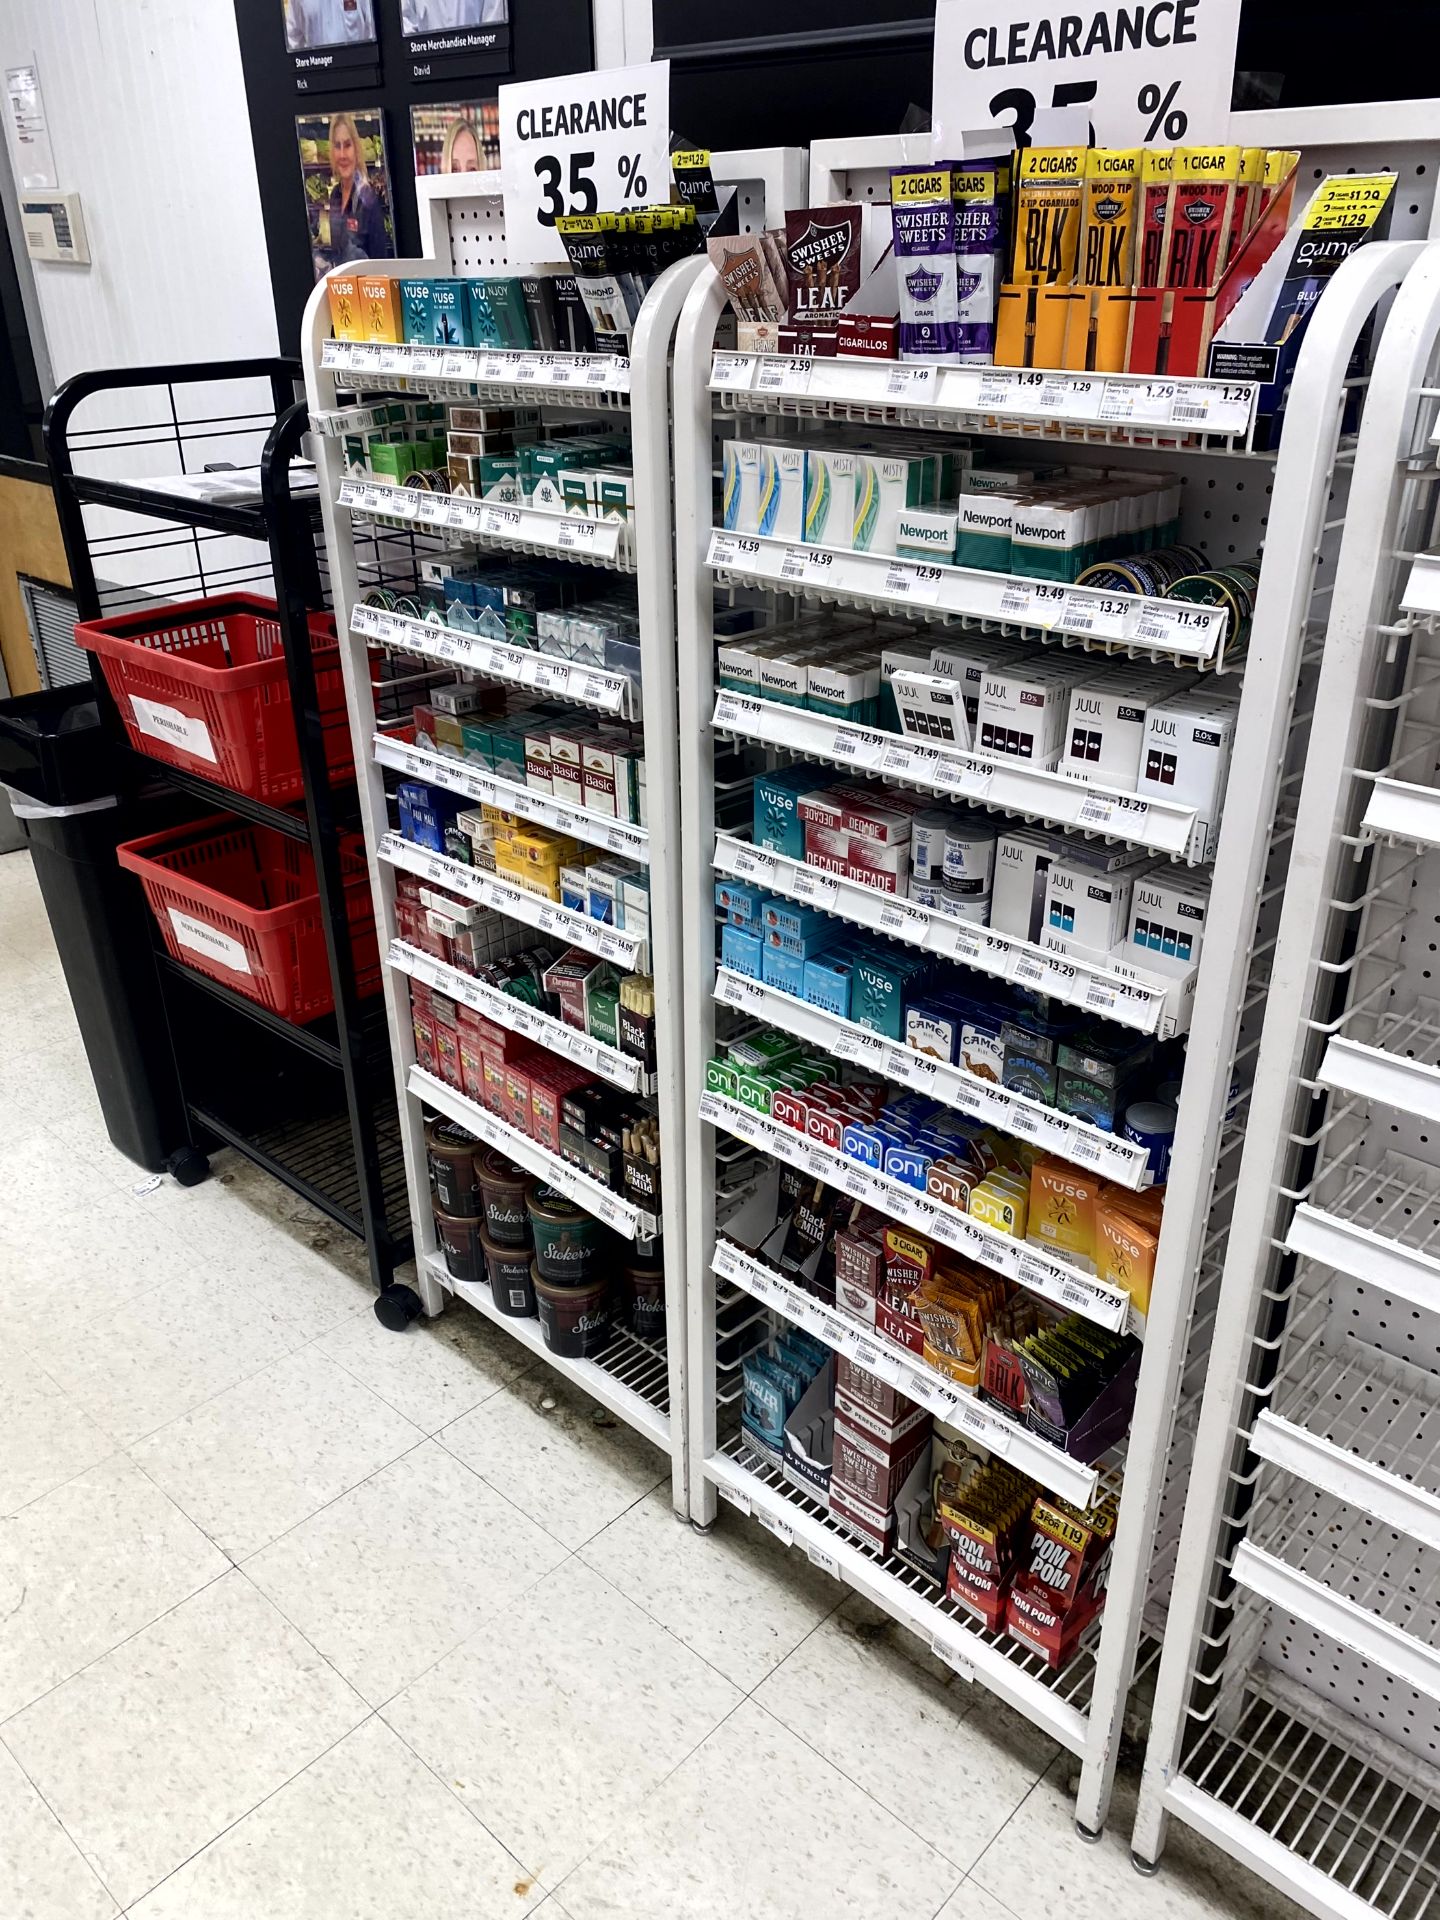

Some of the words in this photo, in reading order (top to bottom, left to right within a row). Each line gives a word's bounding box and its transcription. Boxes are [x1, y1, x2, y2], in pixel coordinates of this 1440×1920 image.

[410, 42, 427, 53] Store
[427, 37, 467, 51] Merchandise
[467, 33, 496, 48] Manager
[963, 0, 1200, 70] CLEARANCE
[295, 58, 309, 68] Store
[309, 55, 333, 67] Manager
[413, 65, 431, 76] David
[296, 79, 308, 89] Rick
[516, 93, 647, 141] CLEARANCE
[1137, 80, 1188, 142] %
[1030, 158, 1037, 173] 2
[1039, 156, 1078, 173] CIGARS
[1097, 160, 1101, 172] 1
[1103, 158, 1135, 172] CIGAR
[1183, 157, 1188, 170] 1
[1191, 155, 1226, 170] CIGAR
[533, 151, 598, 227] 35
[617, 153, 648, 199] %
[901, 180, 907, 194] 2
[908, 177, 942, 194] CIGARS
[1091, 183, 1115, 194] WOOD
[1116, 183, 1132, 194] TIP
[1179, 186, 1207, 196] WOOD
[1210, 185, 1225, 196] TIP
[896, 212, 949, 229] SWISHER
[1312, 216, 1323, 229] 2
[1336, 213, 1367, 227] $1.29
[899, 228, 946, 243] SWEETS
[790, 230, 847, 263] SWISHER
[568, 243, 604, 269] game
[798, 243, 845, 269] SWEETS
[1086, 225, 1127, 287] BLK
[724, 256, 758, 287] SWISHER
[583, 287, 614, 297] DIAMOND
[796, 286, 849, 310] LEAF
[839, 337, 888, 350] CIGARILLOS
[789, 359, 811, 371] 2.59
[913, 370, 929, 380] 1.49
[1017, 373, 1043, 386] 1.49
[1072, 382, 1092, 392] 1.29
[1145, 385, 1174, 399] 1.29
[1222, 386, 1252, 402] 1.29
[882, 464, 904, 477] MISTY
[963, 510, 1012, 528] Newport
[577, 524, 595, 535] 11.73
[900, 523, 948, 541] Newport
[1015, 523, 1066, 541] Newport
[737, 539, 760, 553] 14.59
[808, 552, 833, 566] 14.59
[915, 566, 942, 580] 12.99
[1034, 585, 1065, 600] 13.49
[1099, 600, 1129, 615] 13.29
[1143, 604, 1159, 612] Grizzly
[1176, 611, 1210, 628] 11.49
[720, 661, 753, 678] Newport
[932, 658, 956, 676] JUUL
[604, 679, 621, 692] 10.57
[761, 672, 798, 690] Newport
[809, 680, 845, 699] Newport
[898, 684, 919, 699] JUUL
[984, 682, 1007, 700] JUUL
[741, 699, 762, 713] 13.49
[1075, 697, 1102, 715] JUUL
[1119, 708, 1137, 717] 3.0%
[152, 714, 189, 737] PERISHABLE
[1150, 718, 1177, 737] JUUL
[860, 731, 884, 745] 12.99
[1194, 730, 1212, 741] 5.0%
[913, 745, 939, 759] 21.49
[527, 761, 552, 779] Basic
[553, 762, 579, 780] Basic
[966, 760, 993, 775] 21.49
[585, 774, 613, 792] Basic
[1117, 796, 1148, 813] 13.29
[1001, 845, 1024, 863] JUUL
[806, 851, 845, 876] DECADE
[561, 872, 585, 890] Parliament
[587, 872, 613, 890] Parliament
[820, 876, 838, 889] 4.49
[849, 866, 892, 893] DECADE
[1052, 873, 1074, 892] JUUL
[1137, 890, 1163, 909] JUUL
[906, 907, 929, 922] 32.49
[180, 920, 230, 952] NON-PERISHABLE
[986, 936, 1010, 952] 9.99
[618, 941, 633, 953] 14.09
[1048, 959, 1075, 977] 13.29
[745, 984, 764, 998] 14.29
[1119, 984, 1150, 1001] 21.49
[808, 992, 840, 1011] AMERICAN
[589, 1015, 616, 1036] Cheyenne
[622, 1019, 645, 1040] Black
[908, 1019, 949, 1044] CAMEL
[626, 1033, 646, 1050] Mild
[861, 1035, 883, 1049] 27.08
[913, 1056, 937, 1074] 12.49
[1007, 1057, 1049, 1083] CAMEL
[707, 1069, 731, 1091] on!
[739, 1085, 765, 1107] on!
[985, 1087, 1011, 1105] 12.49
[1064, 1080, 1109, 1107] CAMEL
[722, 1102, 739, 1115] 4.99
[774, 1100, 800, 1122] on!
[760, 1121, 777, 1135] 4.99
[809, 1117, 834, 1141] on!
[1042, 1113, 1070, 1131] 12.49
[844, 1135, 873, 1160] on!
[1105, 1140, 1133, 1159] 32.49
[626, 1164, 652, 1186] Black
[888, 1157, 923, 1178] on!
[631, 1177, 653, 1194] Mild
[928, 1177, 960, 1203] on!
[914, 1199, 935, 1215] 4.99
[799, 1205, 826, 1229] Black
[800, 1220, 824, 1241] Mild
[964, 1225, 984, 1242] 4.99
[544, 1243, 595, 1262] Stoker's
[840, 1241, 871, 1263] SWISHER
[892, 1236, 898, 1246] 3
[899, 1238, 923, 1260] CIGARS
[842, 1250, 871, 1271] SWEETS
[885, 1293, 918, 1320] LEAF
[1093, 1287, 1122, 1309] 17.29
[883, 1317, 913, 1345] LEAF
[938, 1387, 958, 1404] 2.49
[854, 1411, 887, 1436] PERFECTO
[841, 1443, 878, 1474] SWISHER
[843, 1455, 876, 1480] SWEETS
[794, 1459, 828, 1487] PUNCH
[848, 1501, 881, 1525] PERFECTO
[1044, 1516, 1060, 1531] FOR
[1062, 1522, 1083, 1544] 1.19
[950, 1527, 984, 1552] POM
[1030, 1532, 1071, 1567] POM
[952, 1560, 968, 1579] POM
[968, 1571, 992, 1591] POM
[1029, 1556, 1072, 1591] POM
[957, 1582, 979, 1602] RED
[1032, 1584, 1049, 1600] RED
[1010, 1590, 1031, 1615] POM
[1031, 1602, 1057, 1627] POM
[1017, 1617, 1041, 1637] RED
